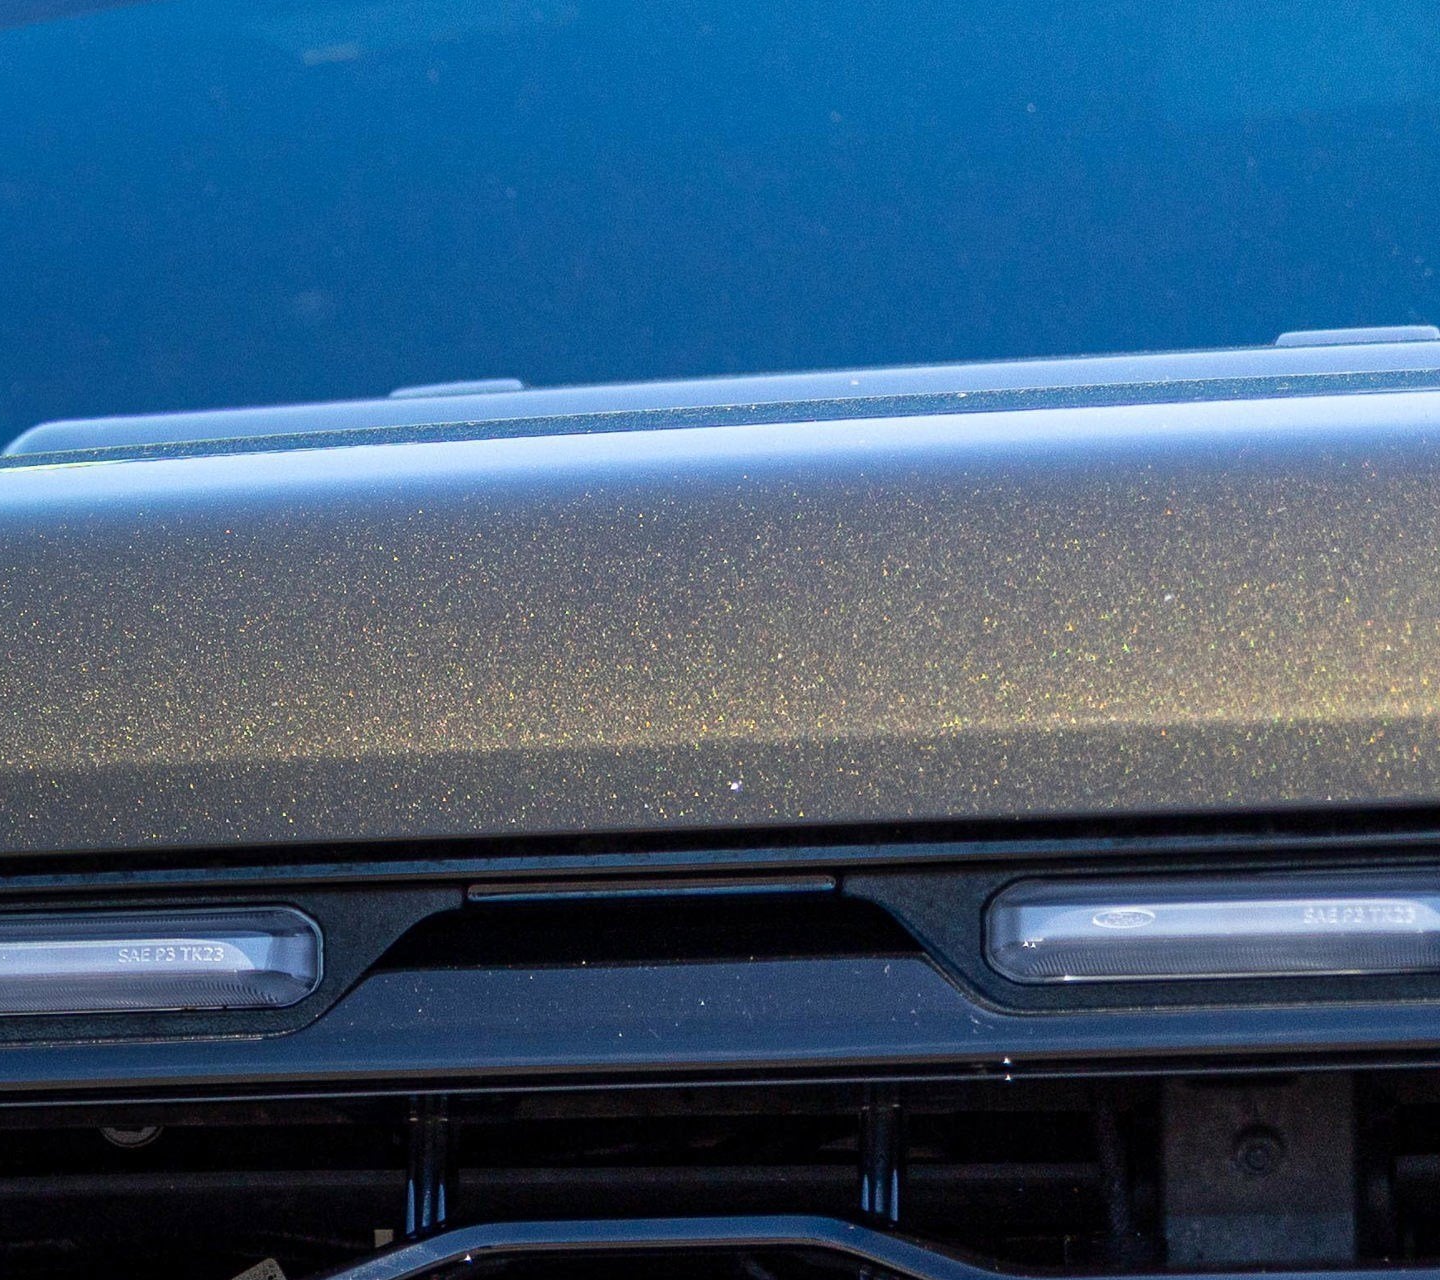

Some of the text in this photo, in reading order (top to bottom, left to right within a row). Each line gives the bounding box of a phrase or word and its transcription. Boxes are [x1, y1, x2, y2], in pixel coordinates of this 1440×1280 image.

[118, 947, 224, 963] SAE P3 TK23
